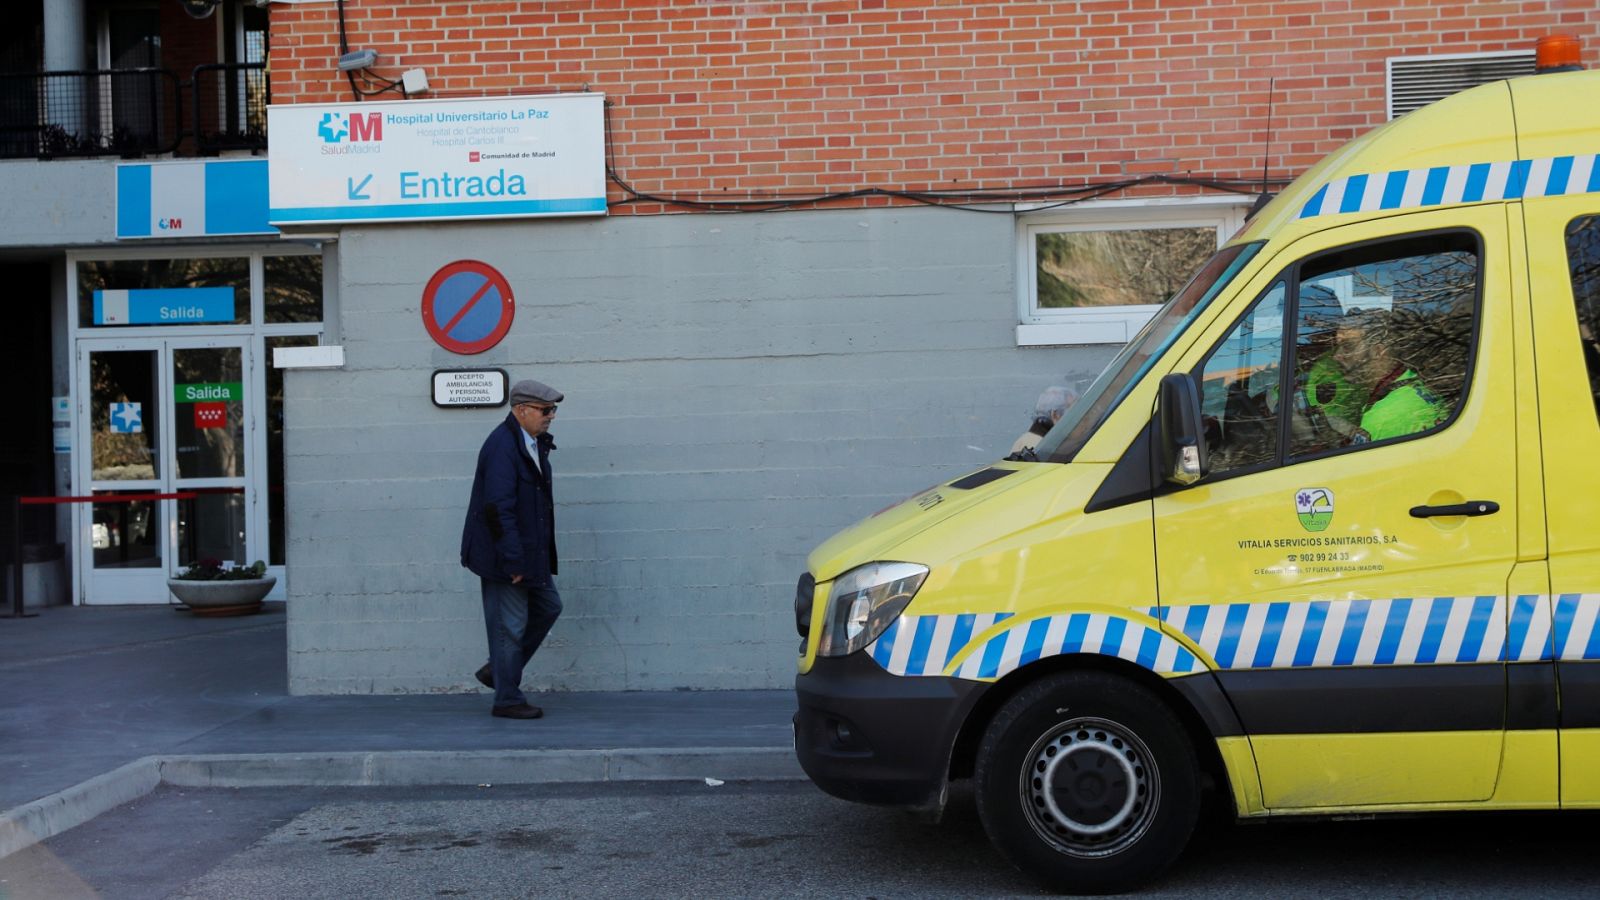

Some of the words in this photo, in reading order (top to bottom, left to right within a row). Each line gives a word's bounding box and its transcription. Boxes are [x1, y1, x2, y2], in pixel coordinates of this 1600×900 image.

[387, 113, 433, 125] Hospital
[436, 111, 508, 122] Universitario
[511, 110, 525, 119] La
[528, 109, 549, 119] Paz
[416, 128, 451, 138] Hospital
[453, 127, 464, 135] de
[466, 126, 519, 135] Cantoblanco
[432, 137, 466, 147] Hospital
[468, 137, 496, 145] Carlos
[399, 168, 527, 199] Entrada
[160, 306, 204, 319] Salida
[186, 386, 230, 399] Salida
[1238, 540, 1272, 549] VITALIA
[1274, 537, 1322, 548] SERVICIOS
[1300, 553, 1315, 562] 902
[1316, 553, 1326, 561] 99
[1328, 552, 1338, 560] 24
[1339, 552, 1350, 561] 33
